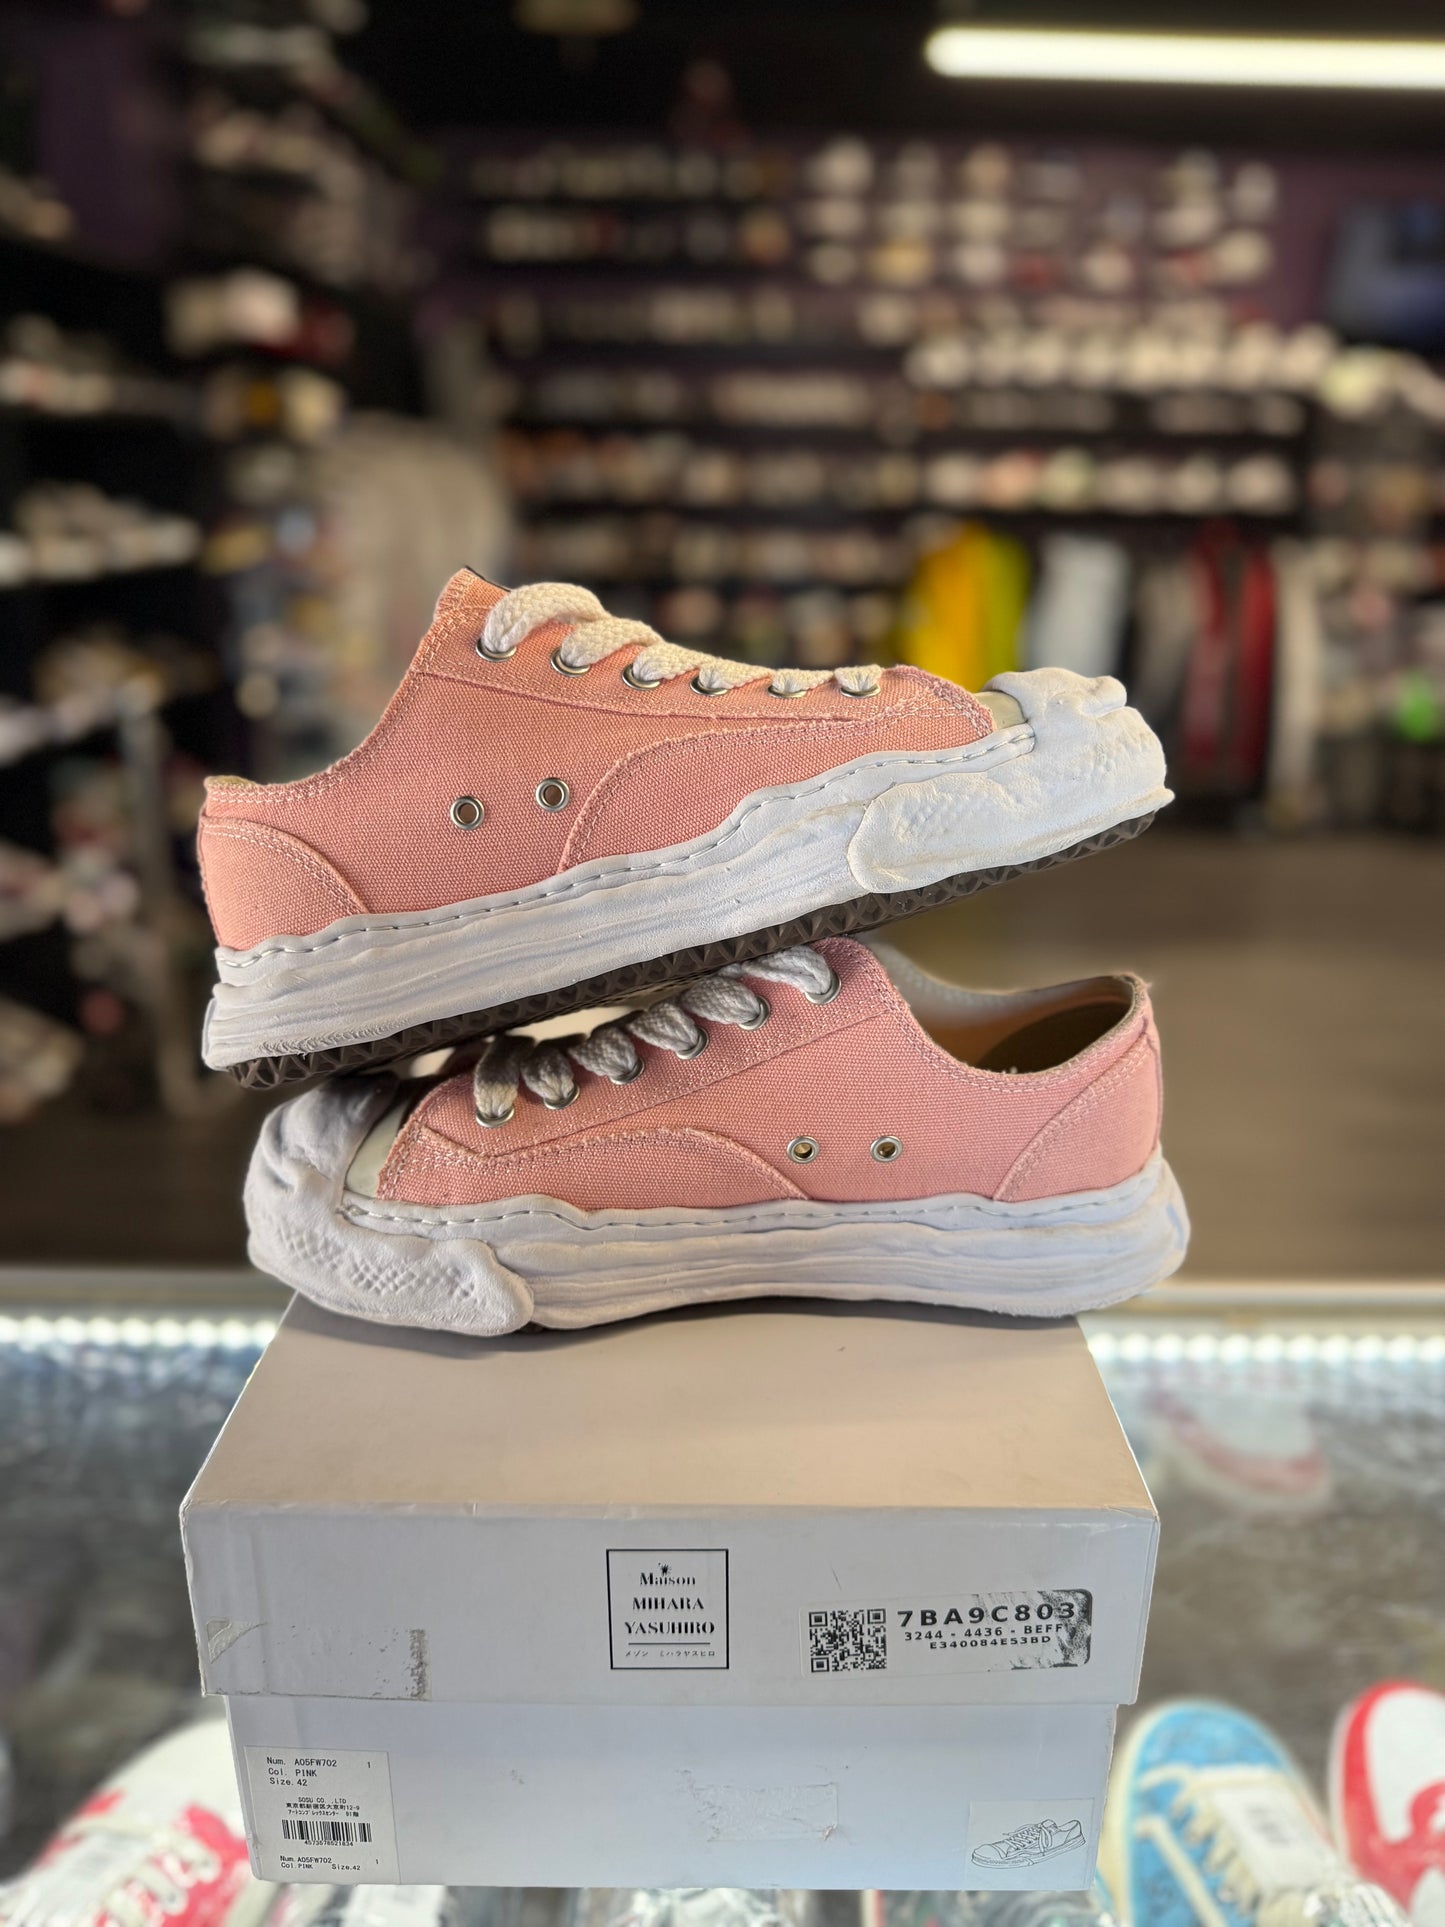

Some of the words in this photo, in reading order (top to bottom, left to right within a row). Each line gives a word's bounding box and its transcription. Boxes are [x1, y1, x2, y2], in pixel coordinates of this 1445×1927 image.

[640, 1571, 696, 1586] Maison
[632, 1597, 705, 1610] MIHARA
[897, 1601, 1076, 1628] 7BA9C803
[624, 1621, 716, 1635] YASUHIRO
[904, 1630, 944, 1642] 3244
[963, 1627, 1003, 1638] 4436
[1023, 1623, 1064, 1635] BEFF
[929, 1636, 1052, 1650] E340084E53BD
[294, 1758, 338, 1768] A05FW702
[295, 1769, 318, 1777] PINK
